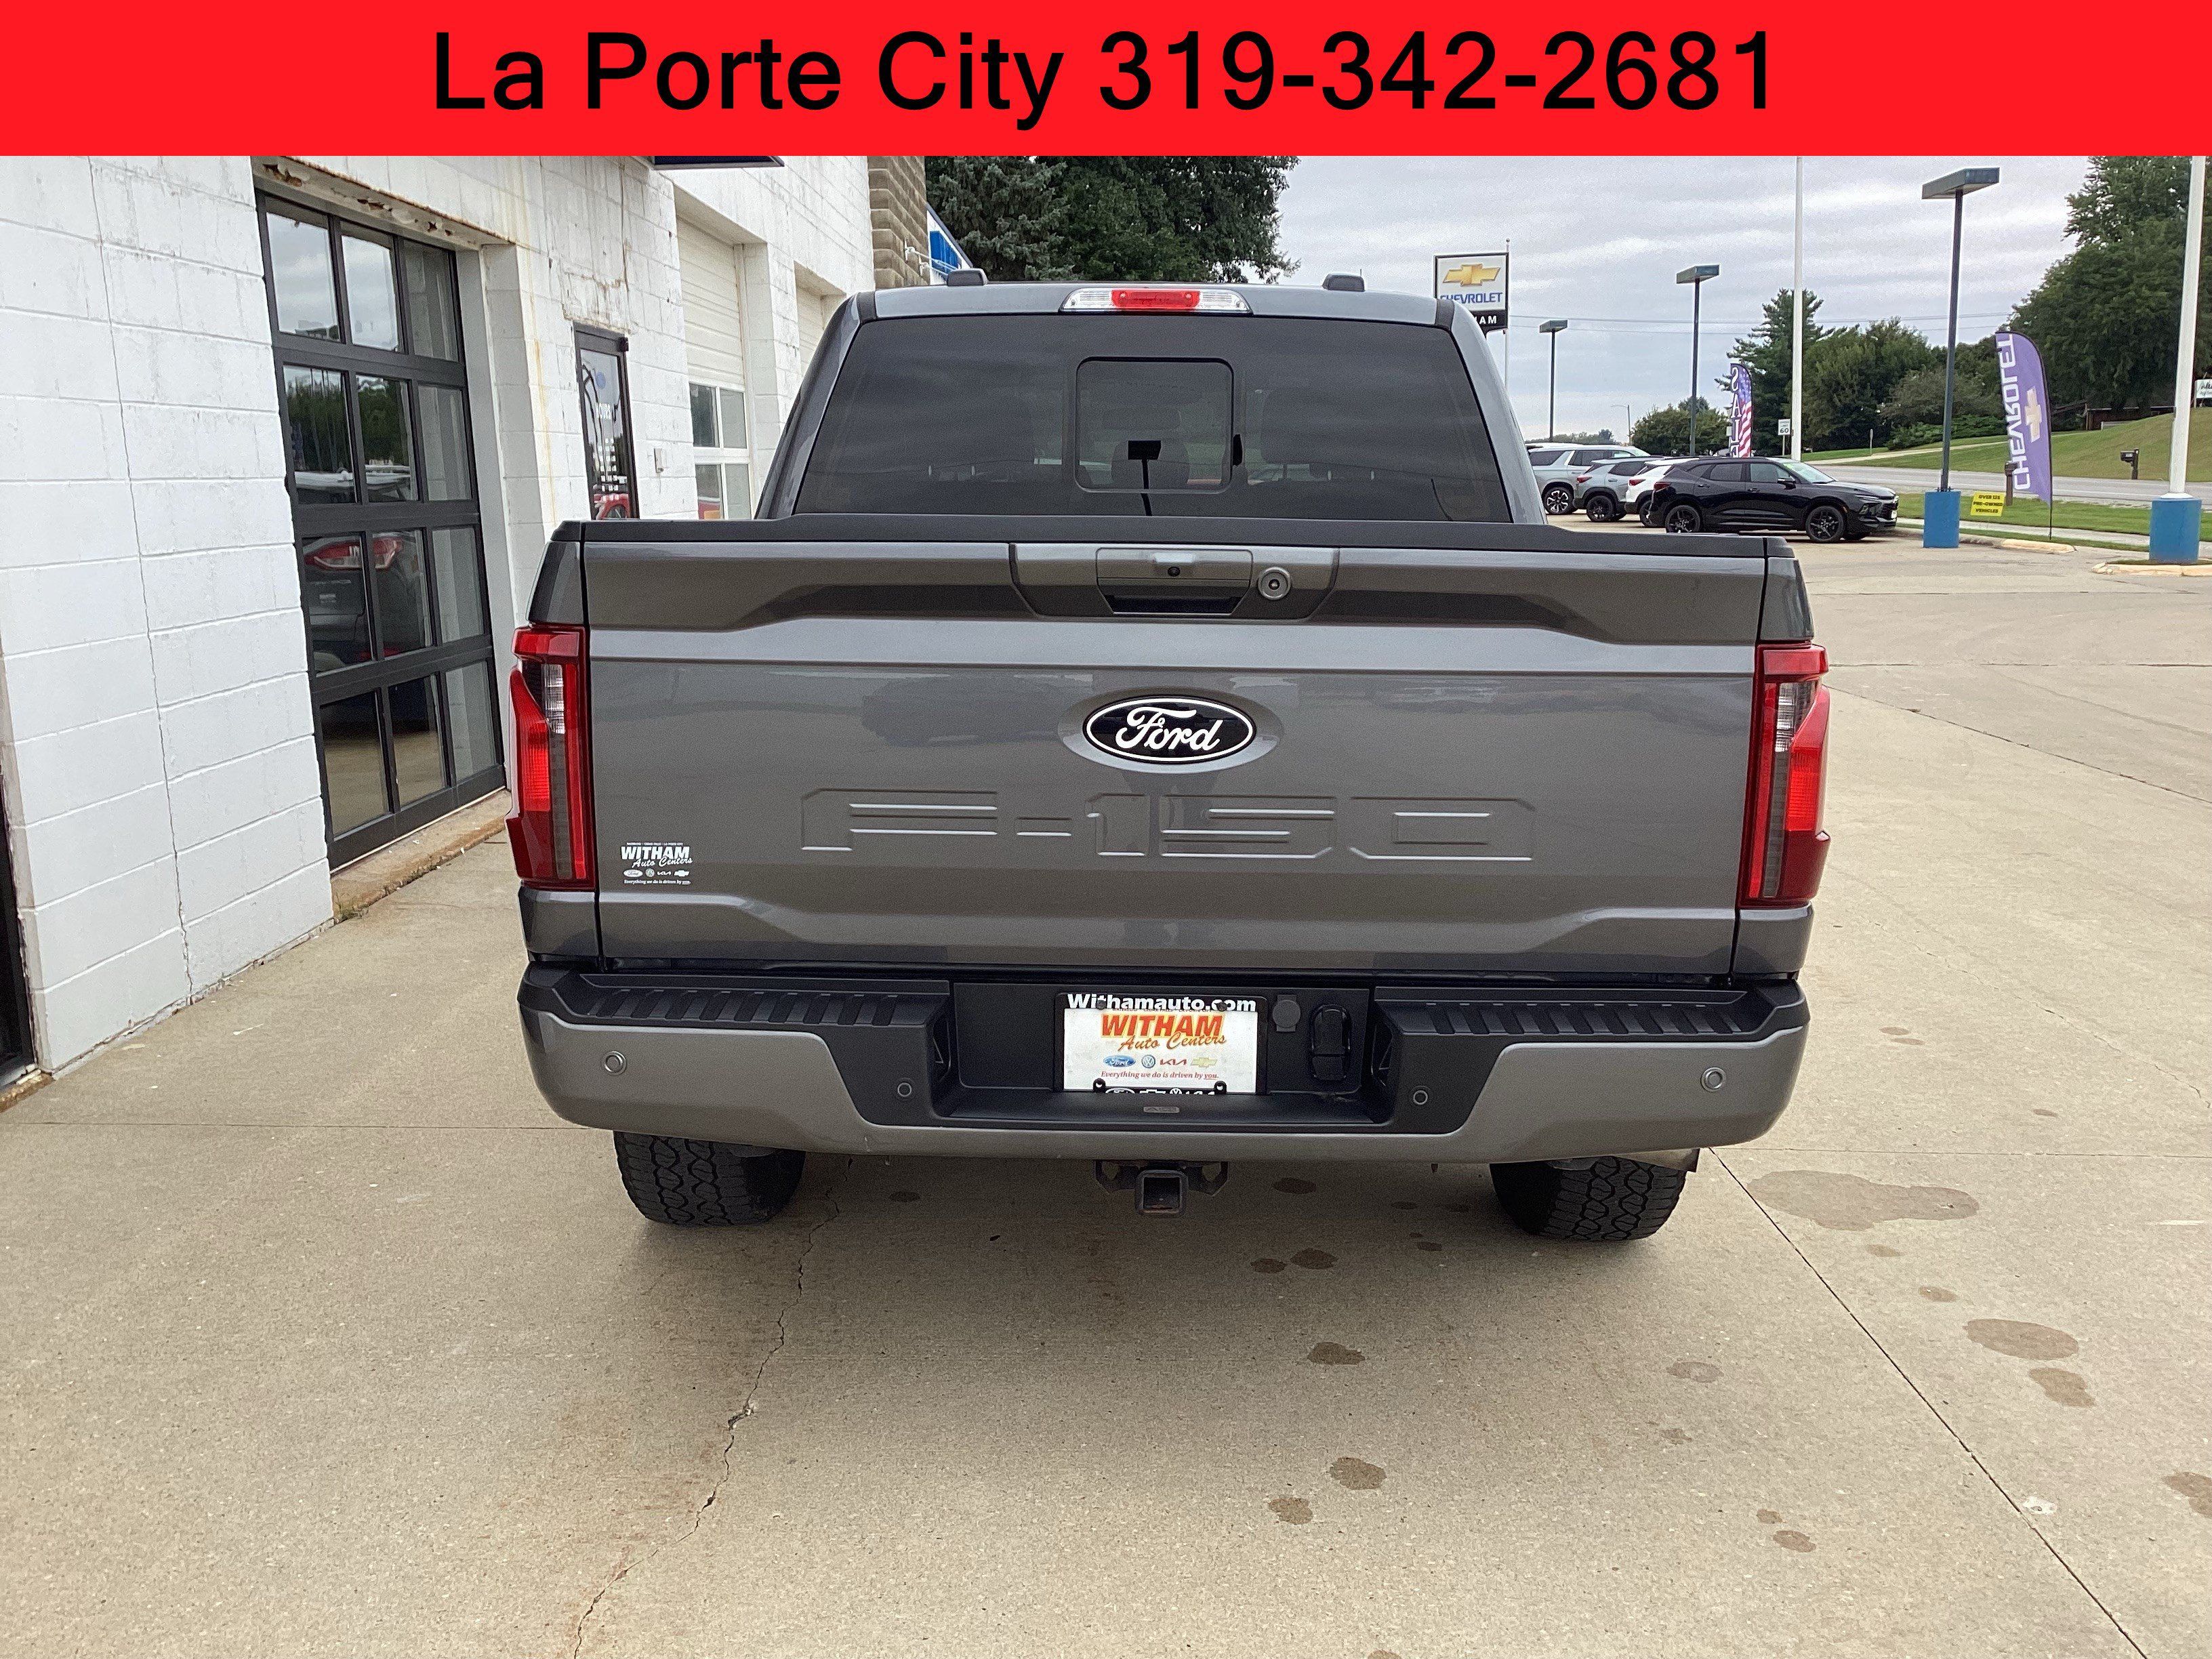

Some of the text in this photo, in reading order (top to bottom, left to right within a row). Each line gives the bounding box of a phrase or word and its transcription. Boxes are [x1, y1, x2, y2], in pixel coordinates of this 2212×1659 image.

[1115, 706, 1223, 751] Ford
[802, 790, 1534, 861] F-150
[621, 846, 690, 859] WITHAM
[632, 856, 693, 868] Auto Centers
[1067, 994, 1256, 1012] Withamauto.com
[1101, 1015, 1223, 1037] WITHAM
[1118, 1032, 1227, 1051] Auto Centers
[1195, 1071, 1204, 1080] by
